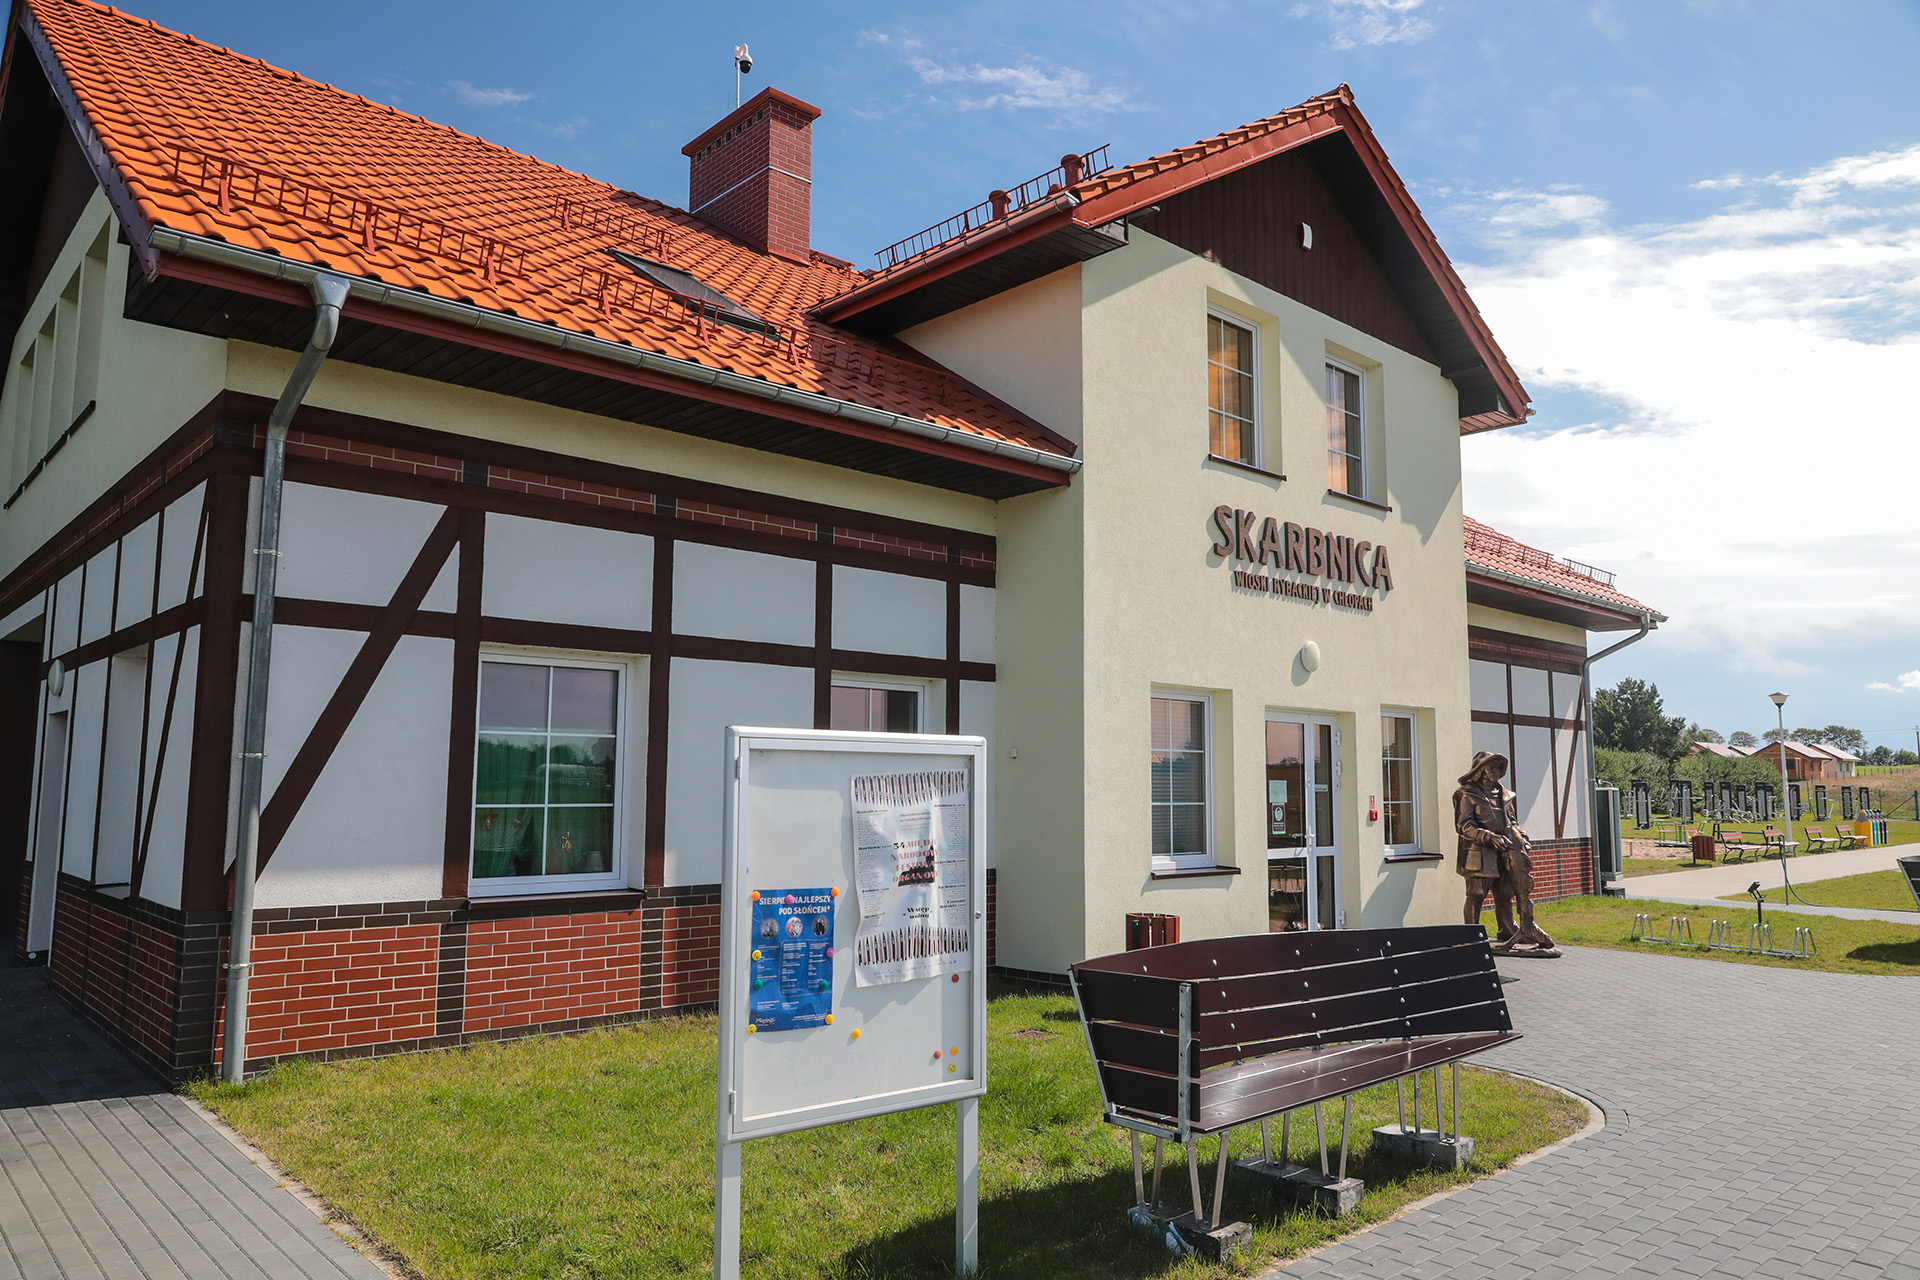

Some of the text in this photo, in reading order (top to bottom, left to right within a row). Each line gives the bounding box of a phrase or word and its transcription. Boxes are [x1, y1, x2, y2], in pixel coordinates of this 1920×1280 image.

[1213, 505, 1394, 592] SKARBNICA
[1234, 570, 1374, 612] WIOSKI RYBACKIEJ W CHŁOPACH
[890, 849, 938, 861] NARODOW
[896, 860, 936, 871] FESTIWA
[892, 871, 938, 883] ORGANOW
[759, 895, 831, 906] SIERPIE NAJLEPSZY
[778, 907, 793, 915] POD
